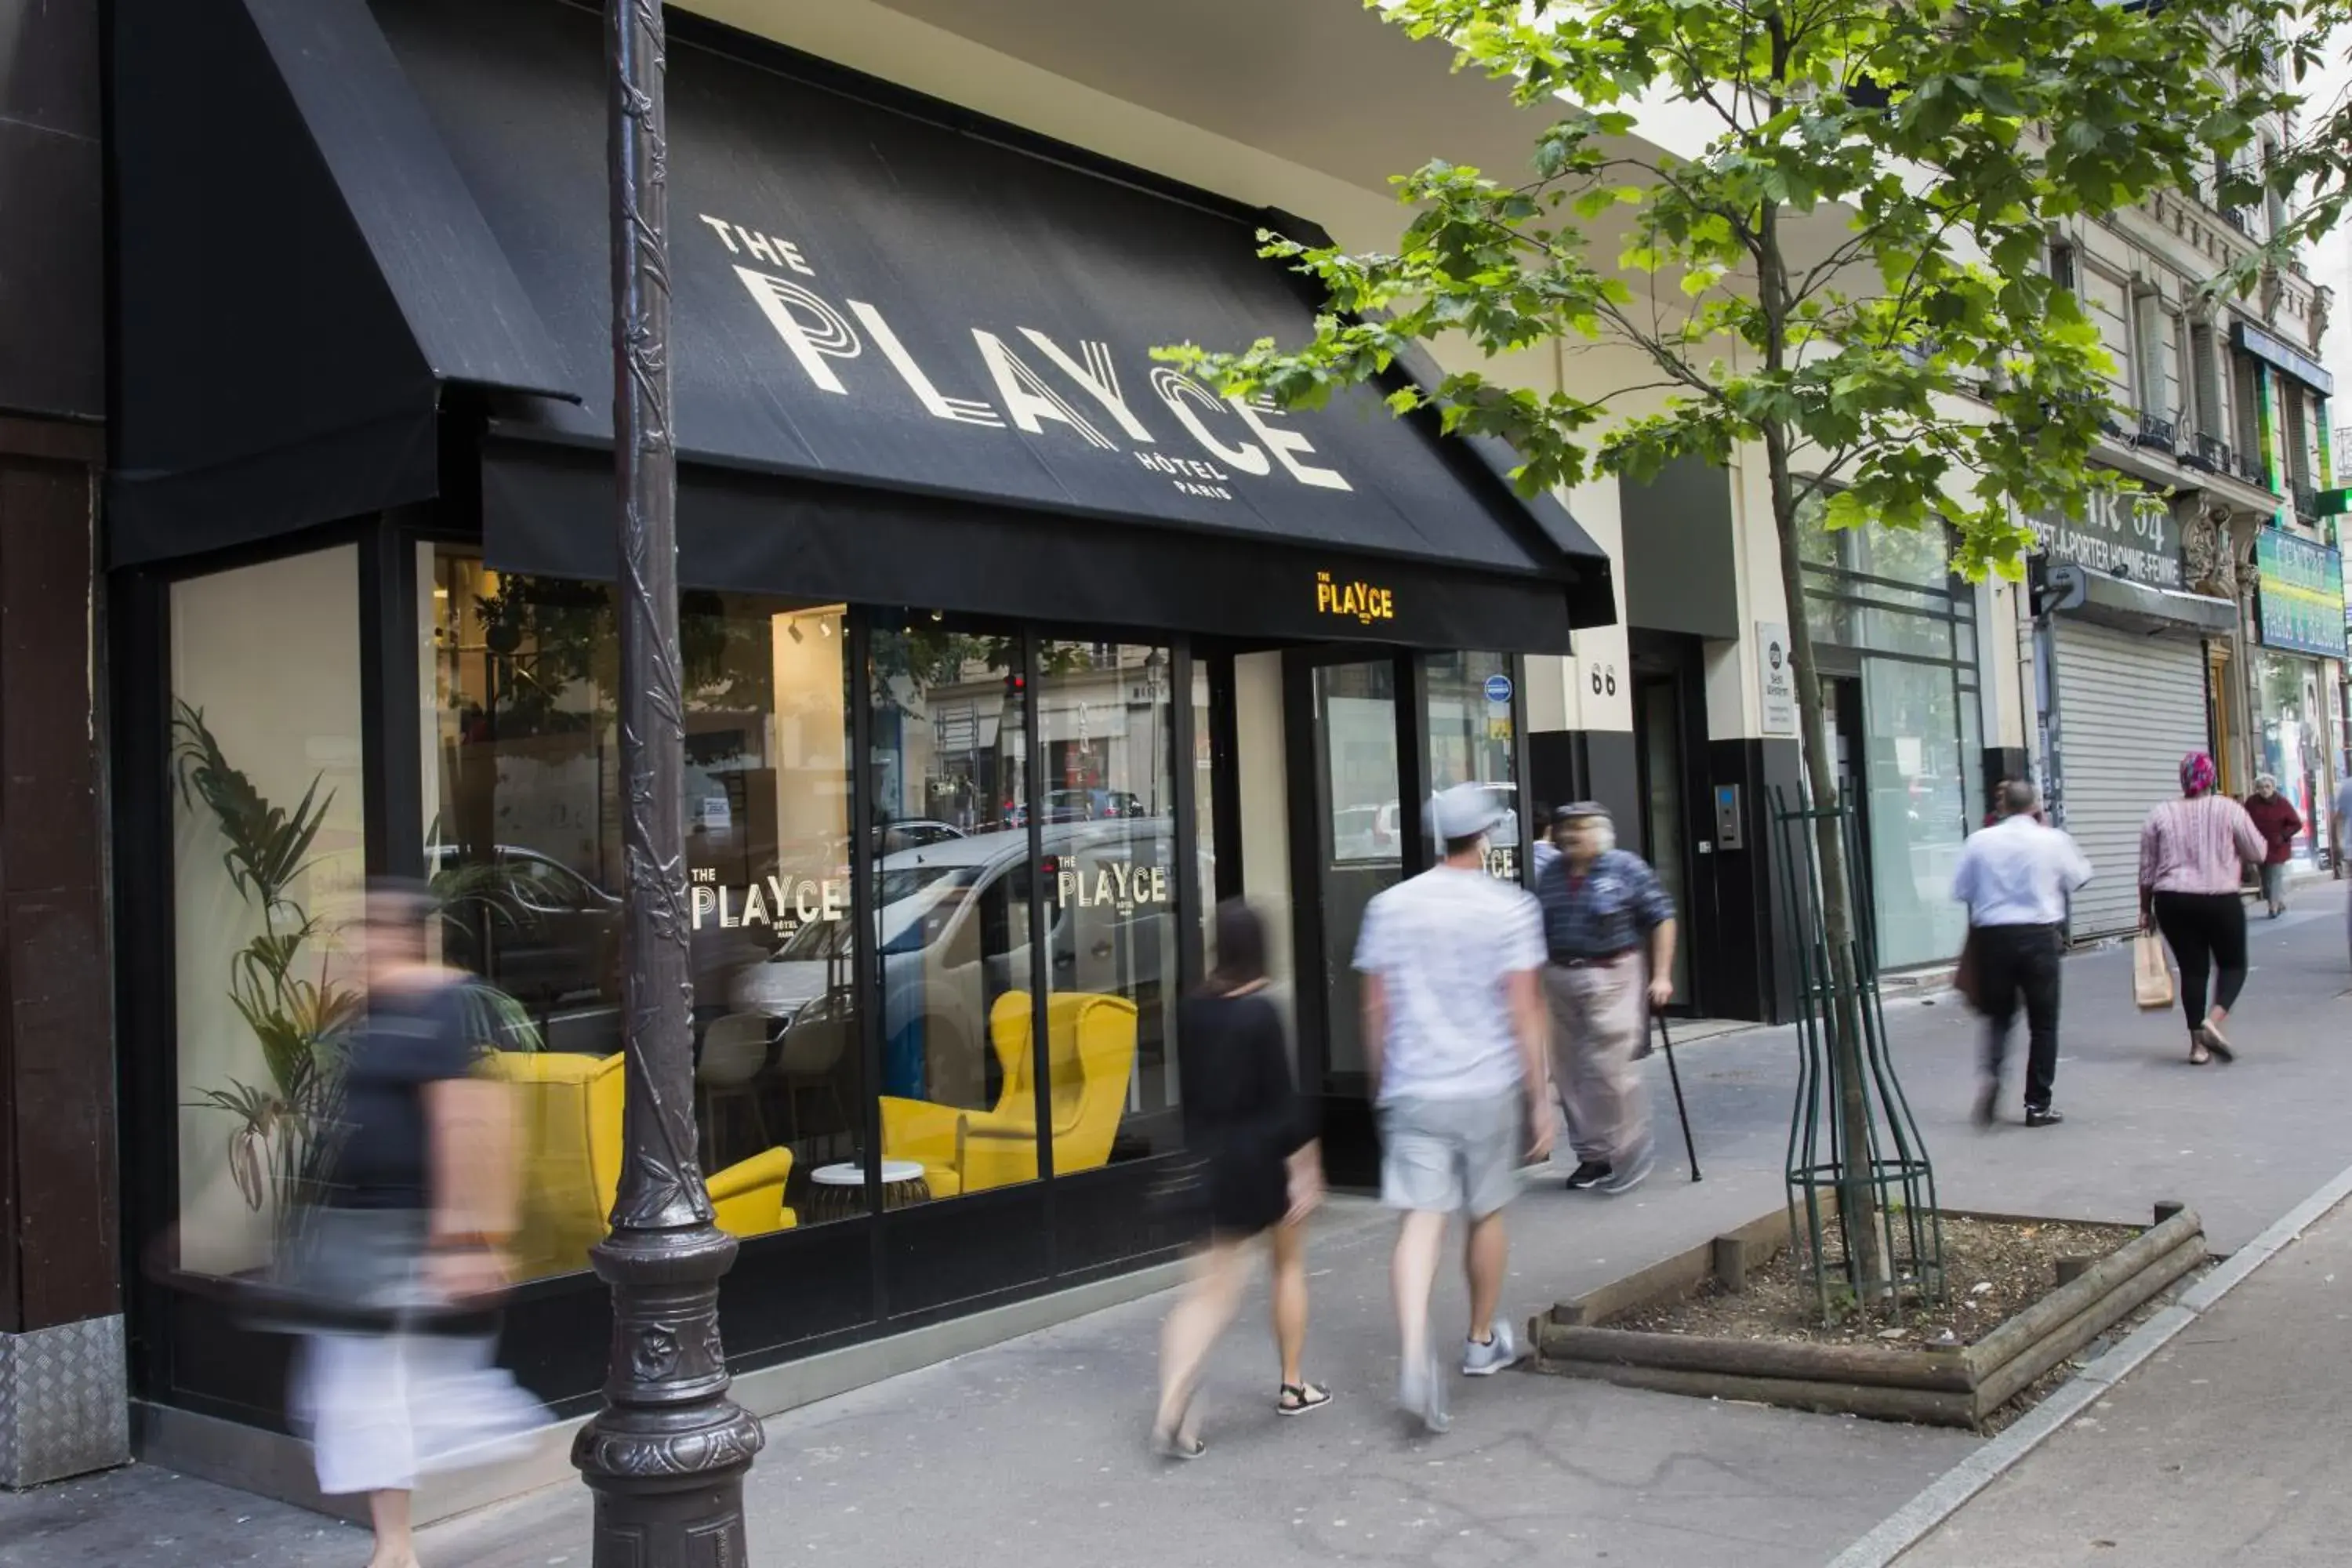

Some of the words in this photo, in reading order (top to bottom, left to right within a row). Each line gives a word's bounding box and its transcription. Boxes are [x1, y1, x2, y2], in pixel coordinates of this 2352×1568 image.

[699, 213, 815, 276] THE
[731, 264, 1354, 491] PLAYCE
[1173, 480, 1232, 500] PARIS
[1317, 572, 1330, 582] THE
[1318, 582, 1392, 618] PLAYCE
[1592, 662, 1616, 696] 66
[691, 868, 716, 881] THE
[1058, 855, 1076, 867] THE
[1058, 861, 1166, 908] PLAYCE
[691, 876, 843, 930] PLAYCE
